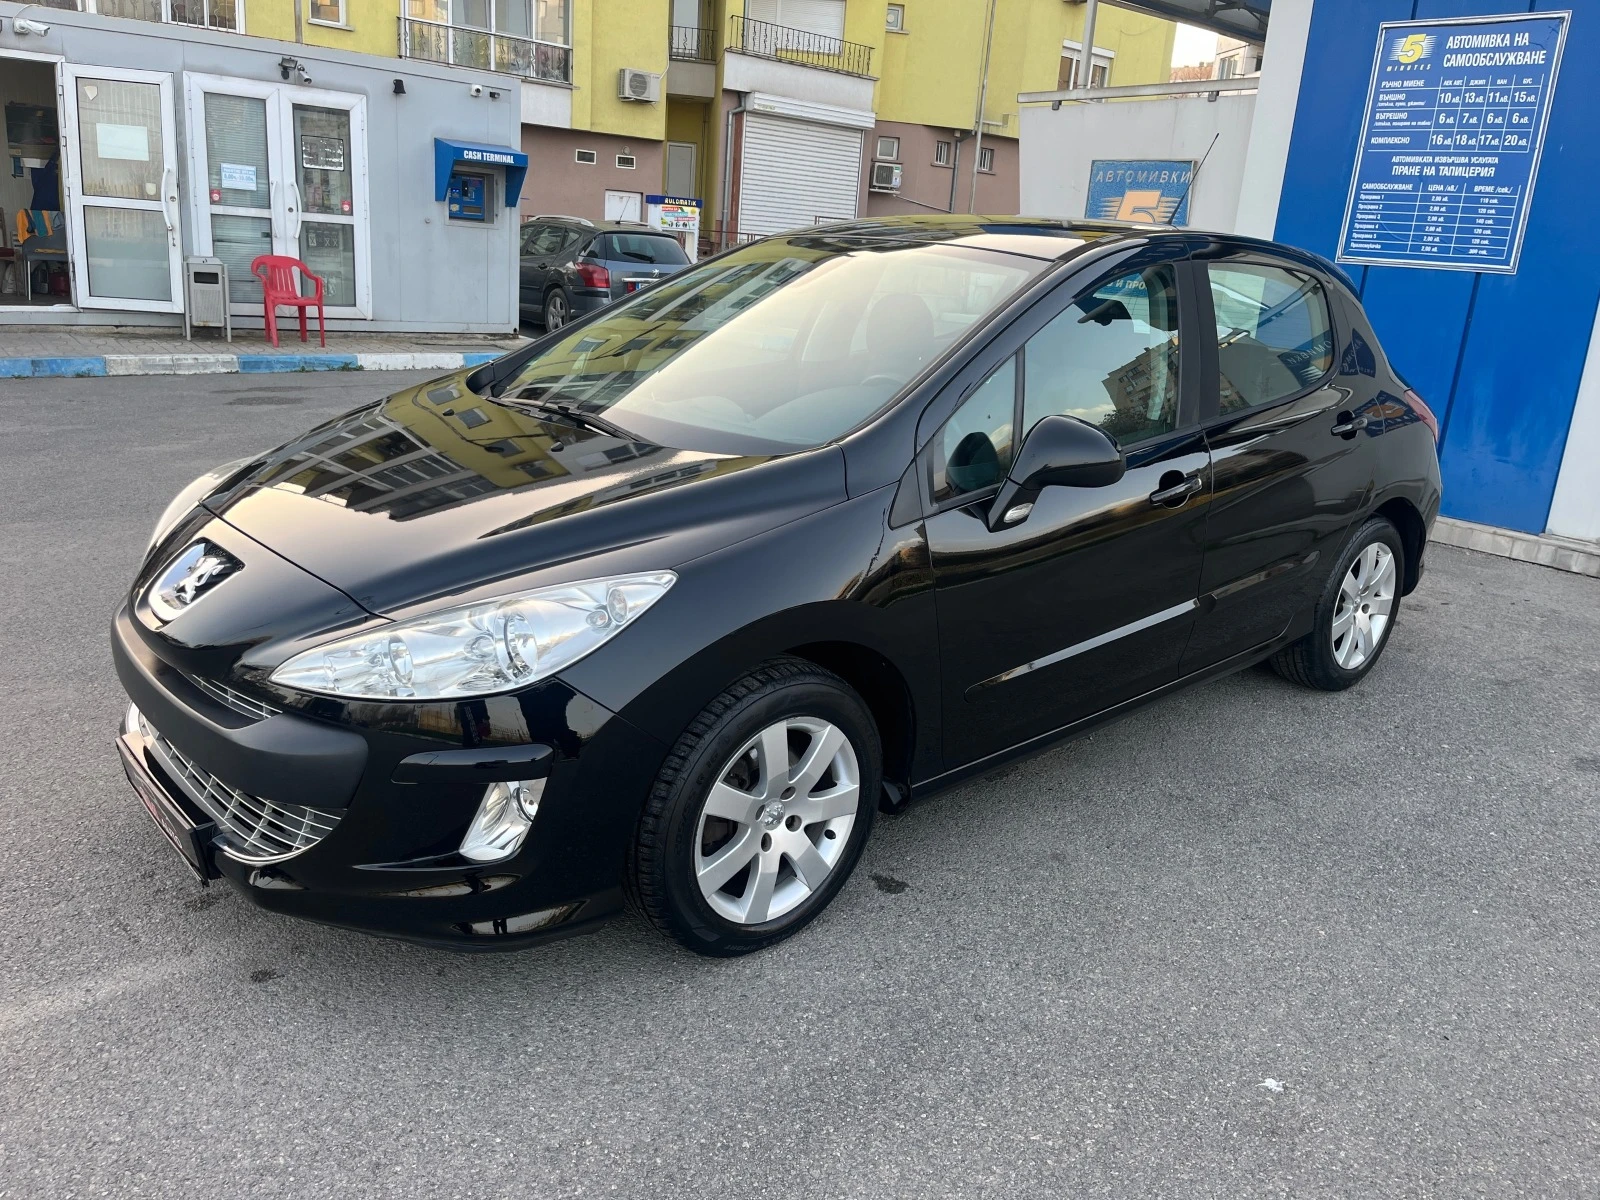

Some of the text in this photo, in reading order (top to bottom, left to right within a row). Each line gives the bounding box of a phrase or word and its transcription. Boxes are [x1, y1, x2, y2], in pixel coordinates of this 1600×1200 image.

[1446, 33, 1529, 49] АВТОМИВКА НА
[1398, 34, 1427, 63] 5
[1444, 50, 1547, 67] САМООБСЛУЖВАНЕ
[1440, 93, 1451, 103] 10
[1465, 92, 1476, 103] 13
[1489, 92, 1500, 102] 11
[1514, 92, 1527, 102] 15
[1439, 113, 1446, 124] 6
[1463, 113, 1469, 124] 7
[1487, 113, 1494, 124] 6
[1512, 113, 1519, 124] 6
[1432, 134, 1444, 145] 16
[1456, 135, 1467, 145] 18
[1480, 135, 1492, 145] 17
[1504, 135, 1518, 145] 20
[464, 150, 514, 163] CASH TERMINAL
[1096, 170, 1191, 183] АВТОМИВКИ
[1392, 166, 1495, 178] ПРАНЕ НА ТАПИЦЕРИЯ
[1126, 281, 1147, 289] ПРО
